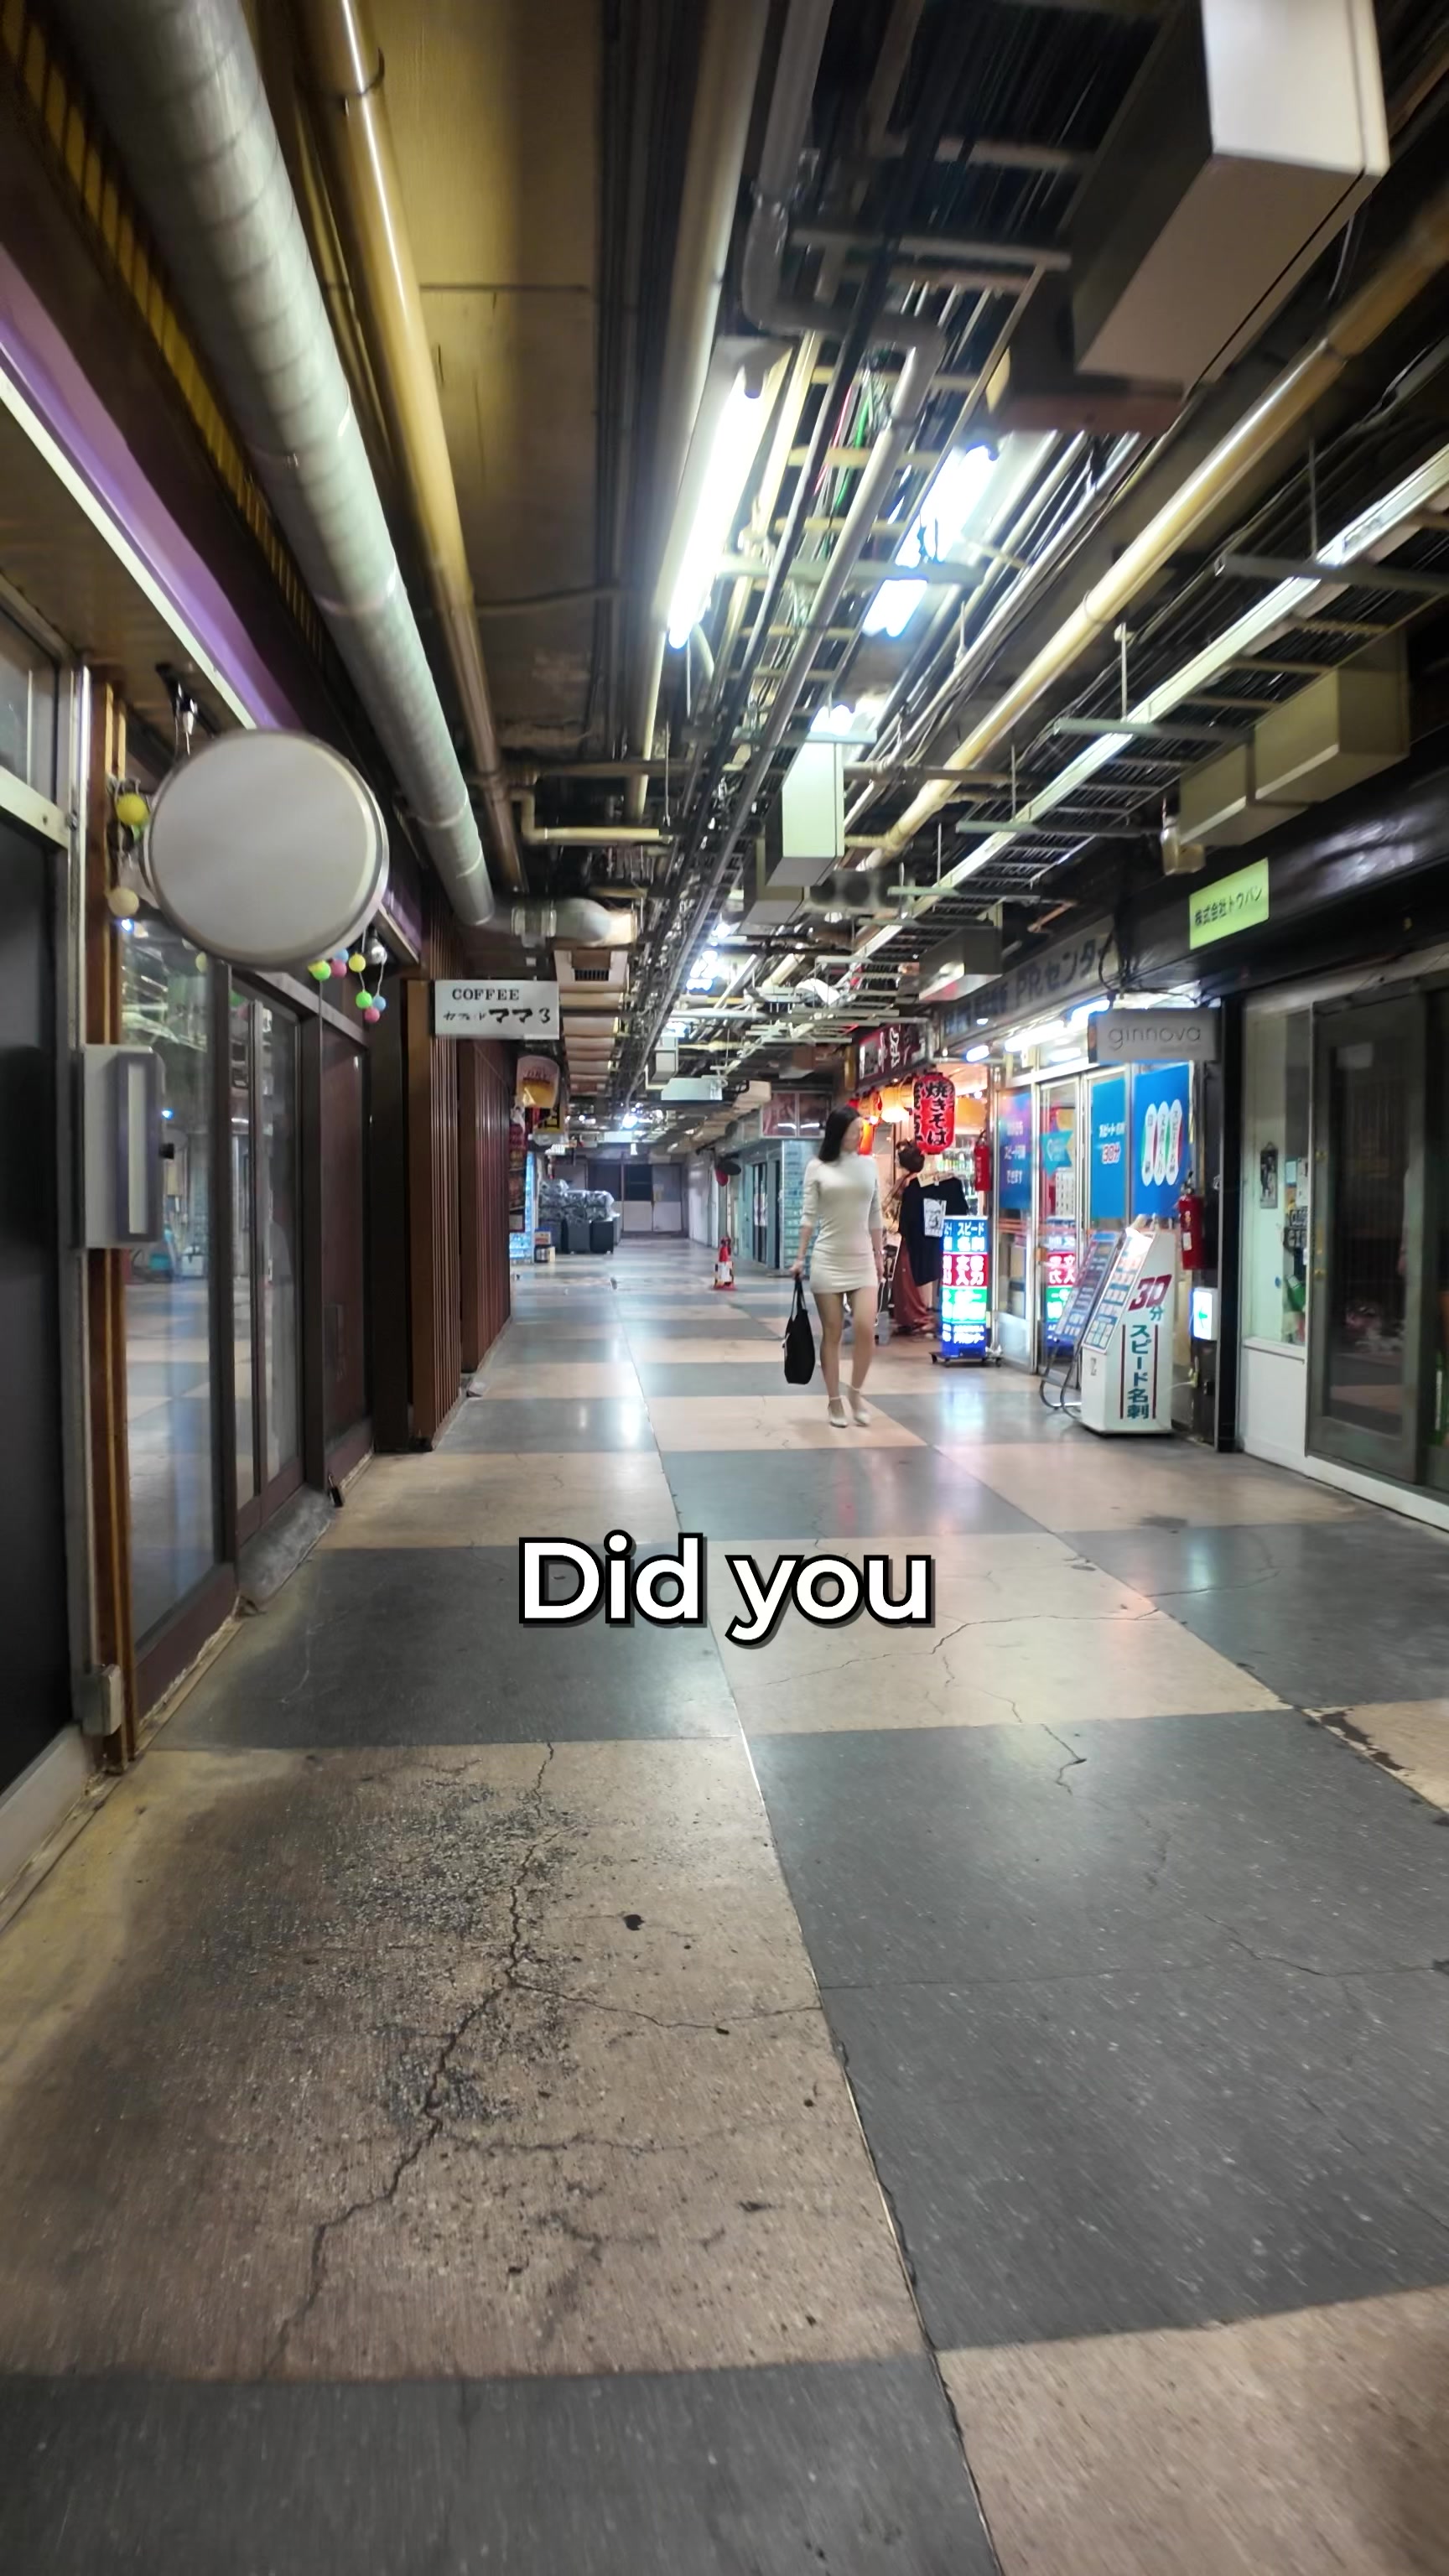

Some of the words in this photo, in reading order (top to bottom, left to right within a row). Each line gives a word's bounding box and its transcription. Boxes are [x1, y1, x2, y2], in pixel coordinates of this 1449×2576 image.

[452, 988, 520, 1001] COFFEE
[1108, 1025, 1202, 1049] ginnova
[925, 1080, 948, 1146] 焼きそば
[957, 1222, 985, 1236] スピード
[1127, 1324, 1150, 1420] スピード名刺
